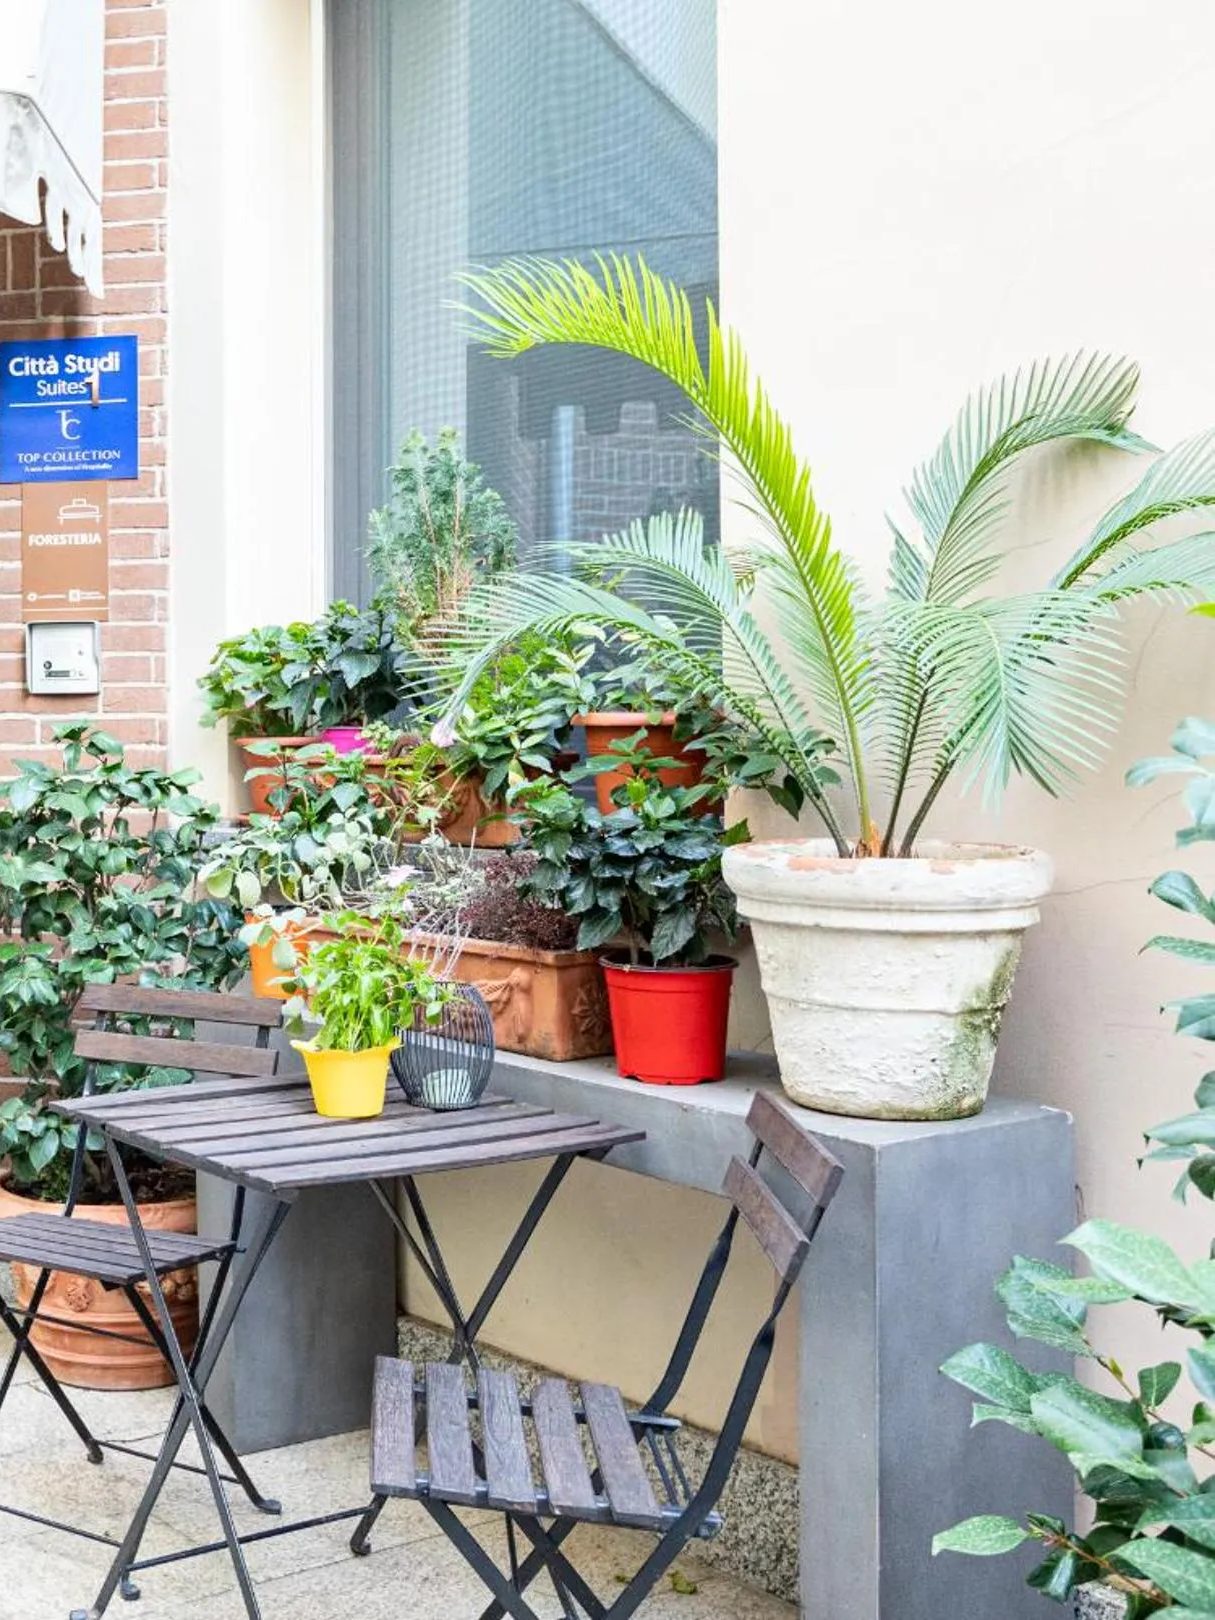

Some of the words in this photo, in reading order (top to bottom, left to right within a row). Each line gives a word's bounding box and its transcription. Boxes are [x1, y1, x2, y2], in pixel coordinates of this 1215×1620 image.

[8, 355, 59, 376] Città
[64, 351, 120, 374] Studi
[36, 379, 87, 397] Suites
[17, 452, 40, 464] TOP
[43, 449, 121, 462] COLLECTION
[28, 533, 102, 547] FORESTERIA
